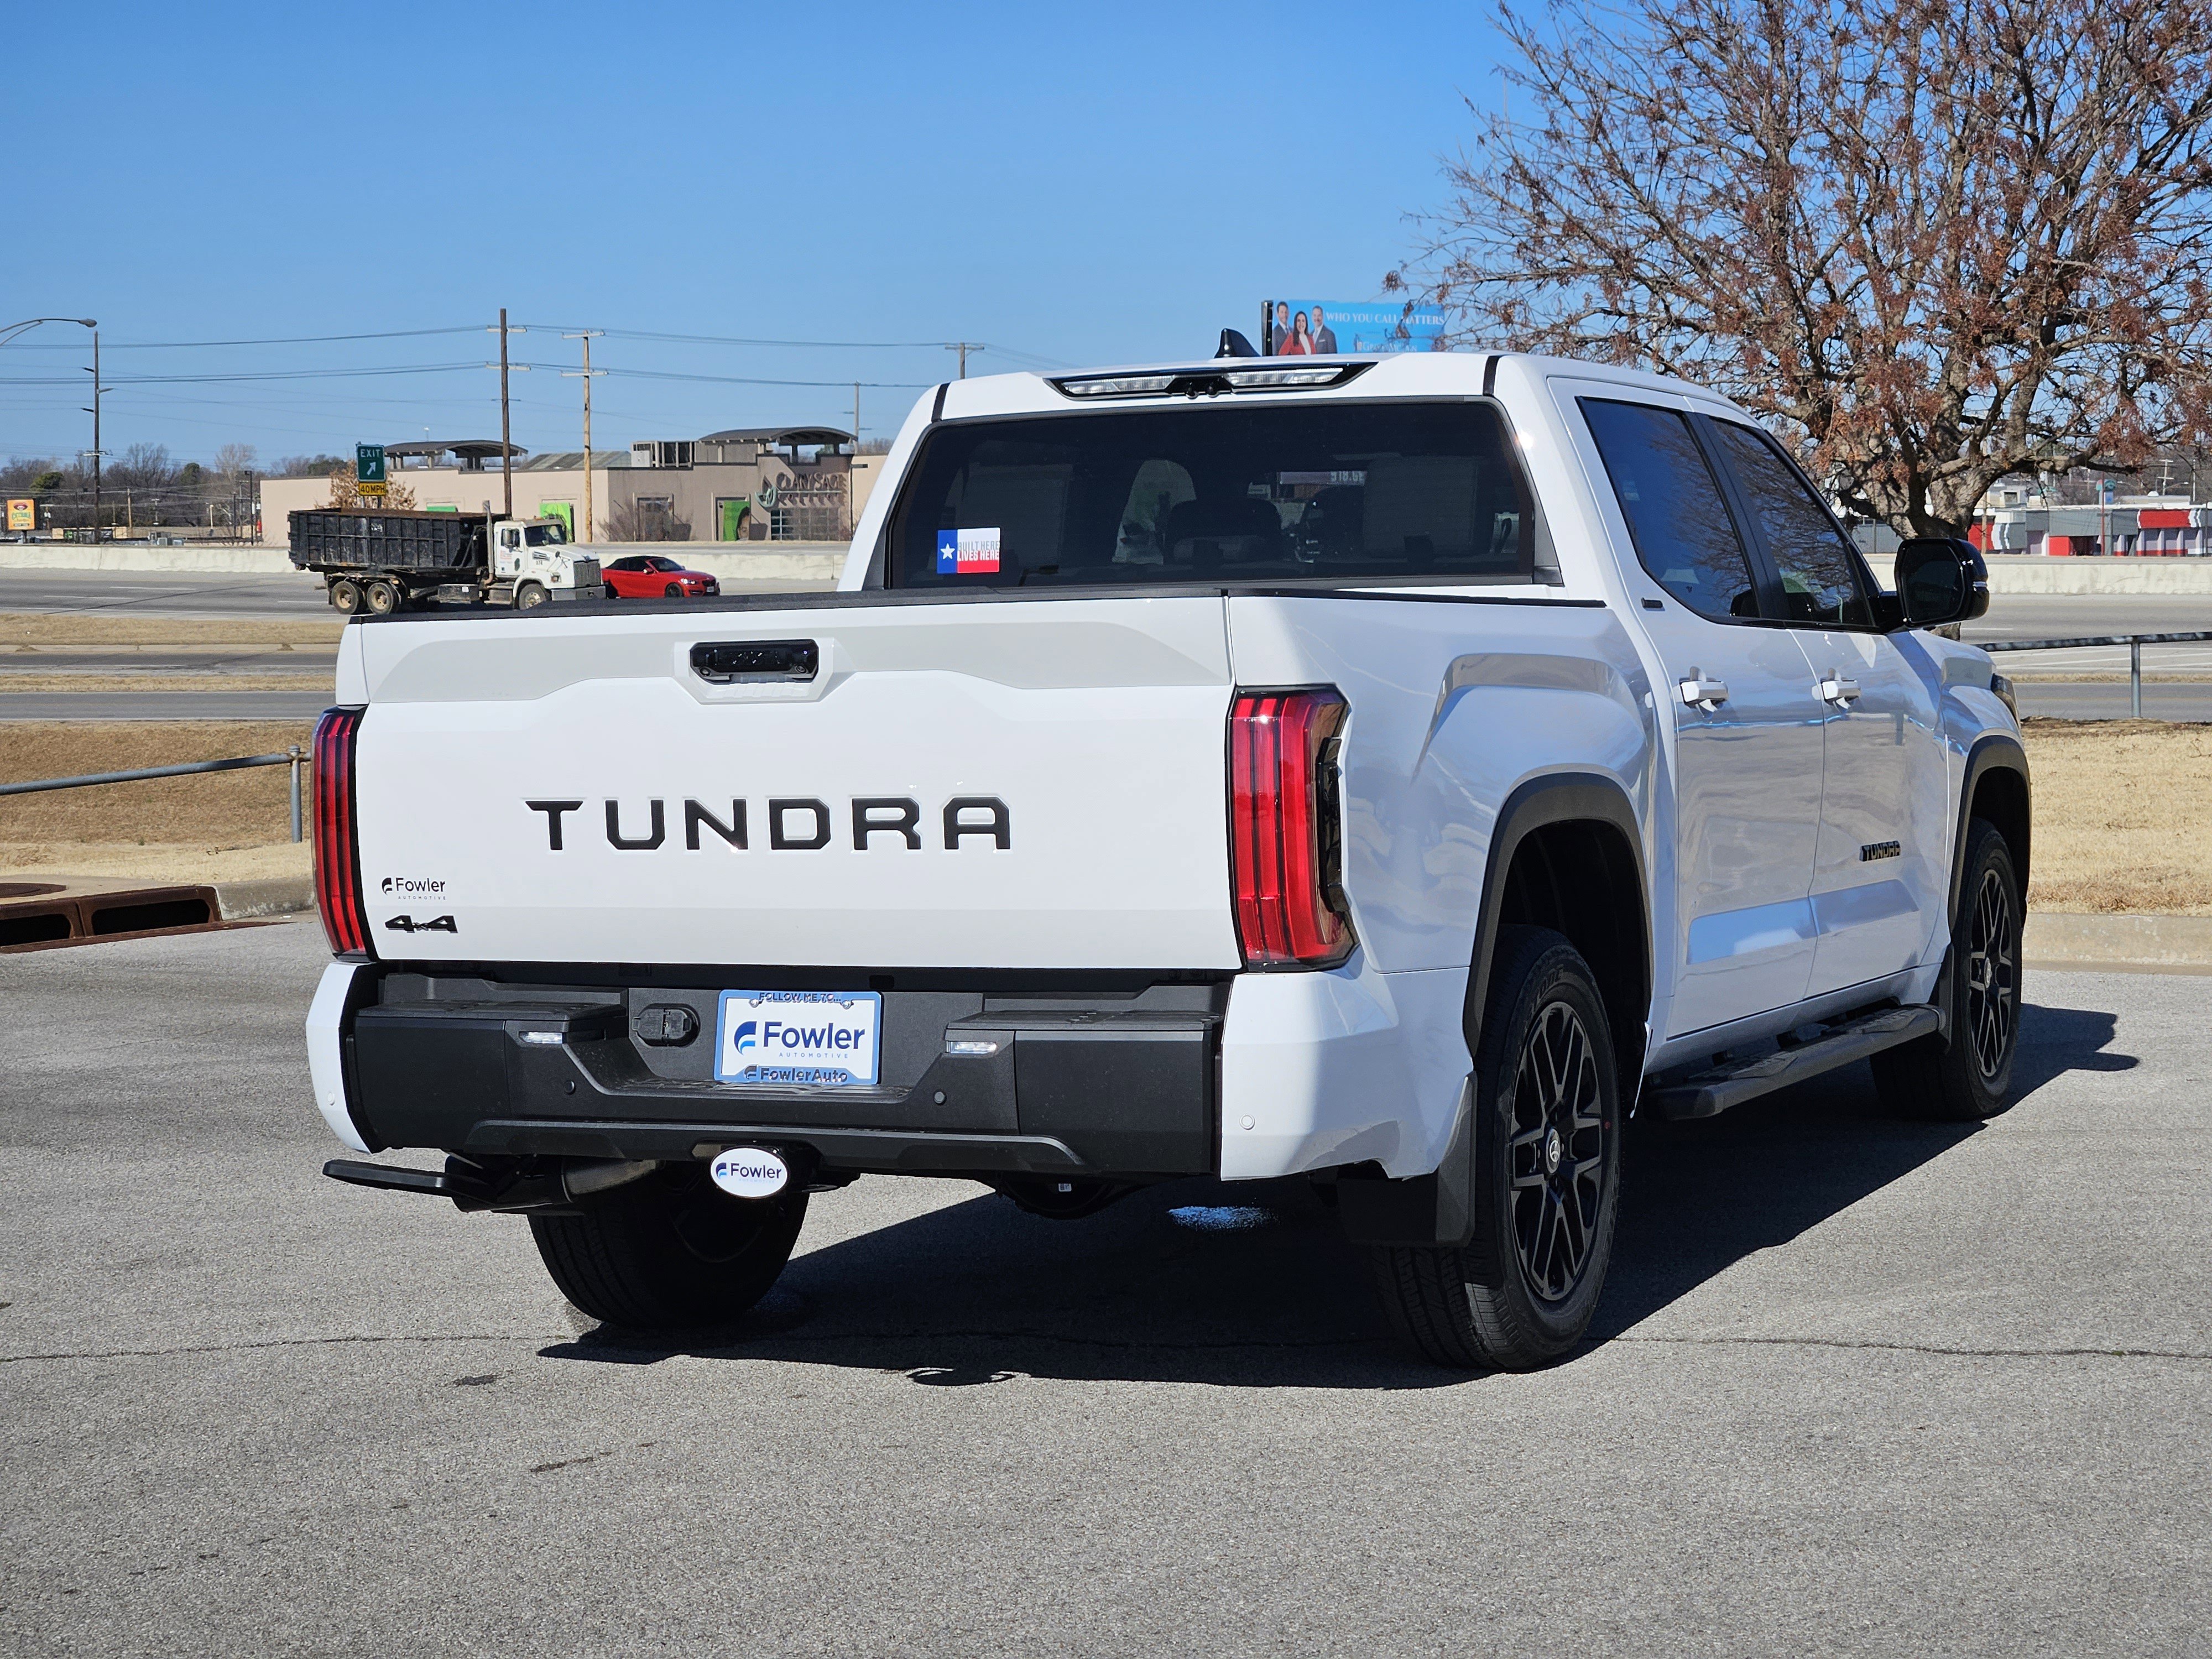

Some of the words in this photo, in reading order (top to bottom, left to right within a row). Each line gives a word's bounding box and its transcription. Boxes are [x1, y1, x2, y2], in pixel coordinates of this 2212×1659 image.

[1326, 312, 1350, 321] WHO
[1353, 313, 1373, 323] YOU
[1375, 314, 1398, 324] CALL
[360, 448, 380, 458] EXIT
[958, 541, 979, 551] BUILT
[980, 540, 999, 551] HERE
[957, 550, 978, 561] LIVES
[980, 550, 999, 560] HERE
[525, 797, 1011, 851] TUNDRA
[1860, 840, 1901, 862] TUNDRA
[395, 877, 446, 892] Fowler
[759, 992, 802, 1003] FOLLOW
[804, 993, 818, 1003] ME
[763, 1021, 865, 1050] Fowler
[760, 1067, 848, 1083] FowlerAuto
[731, 1162, 781, 1179] Fowler
